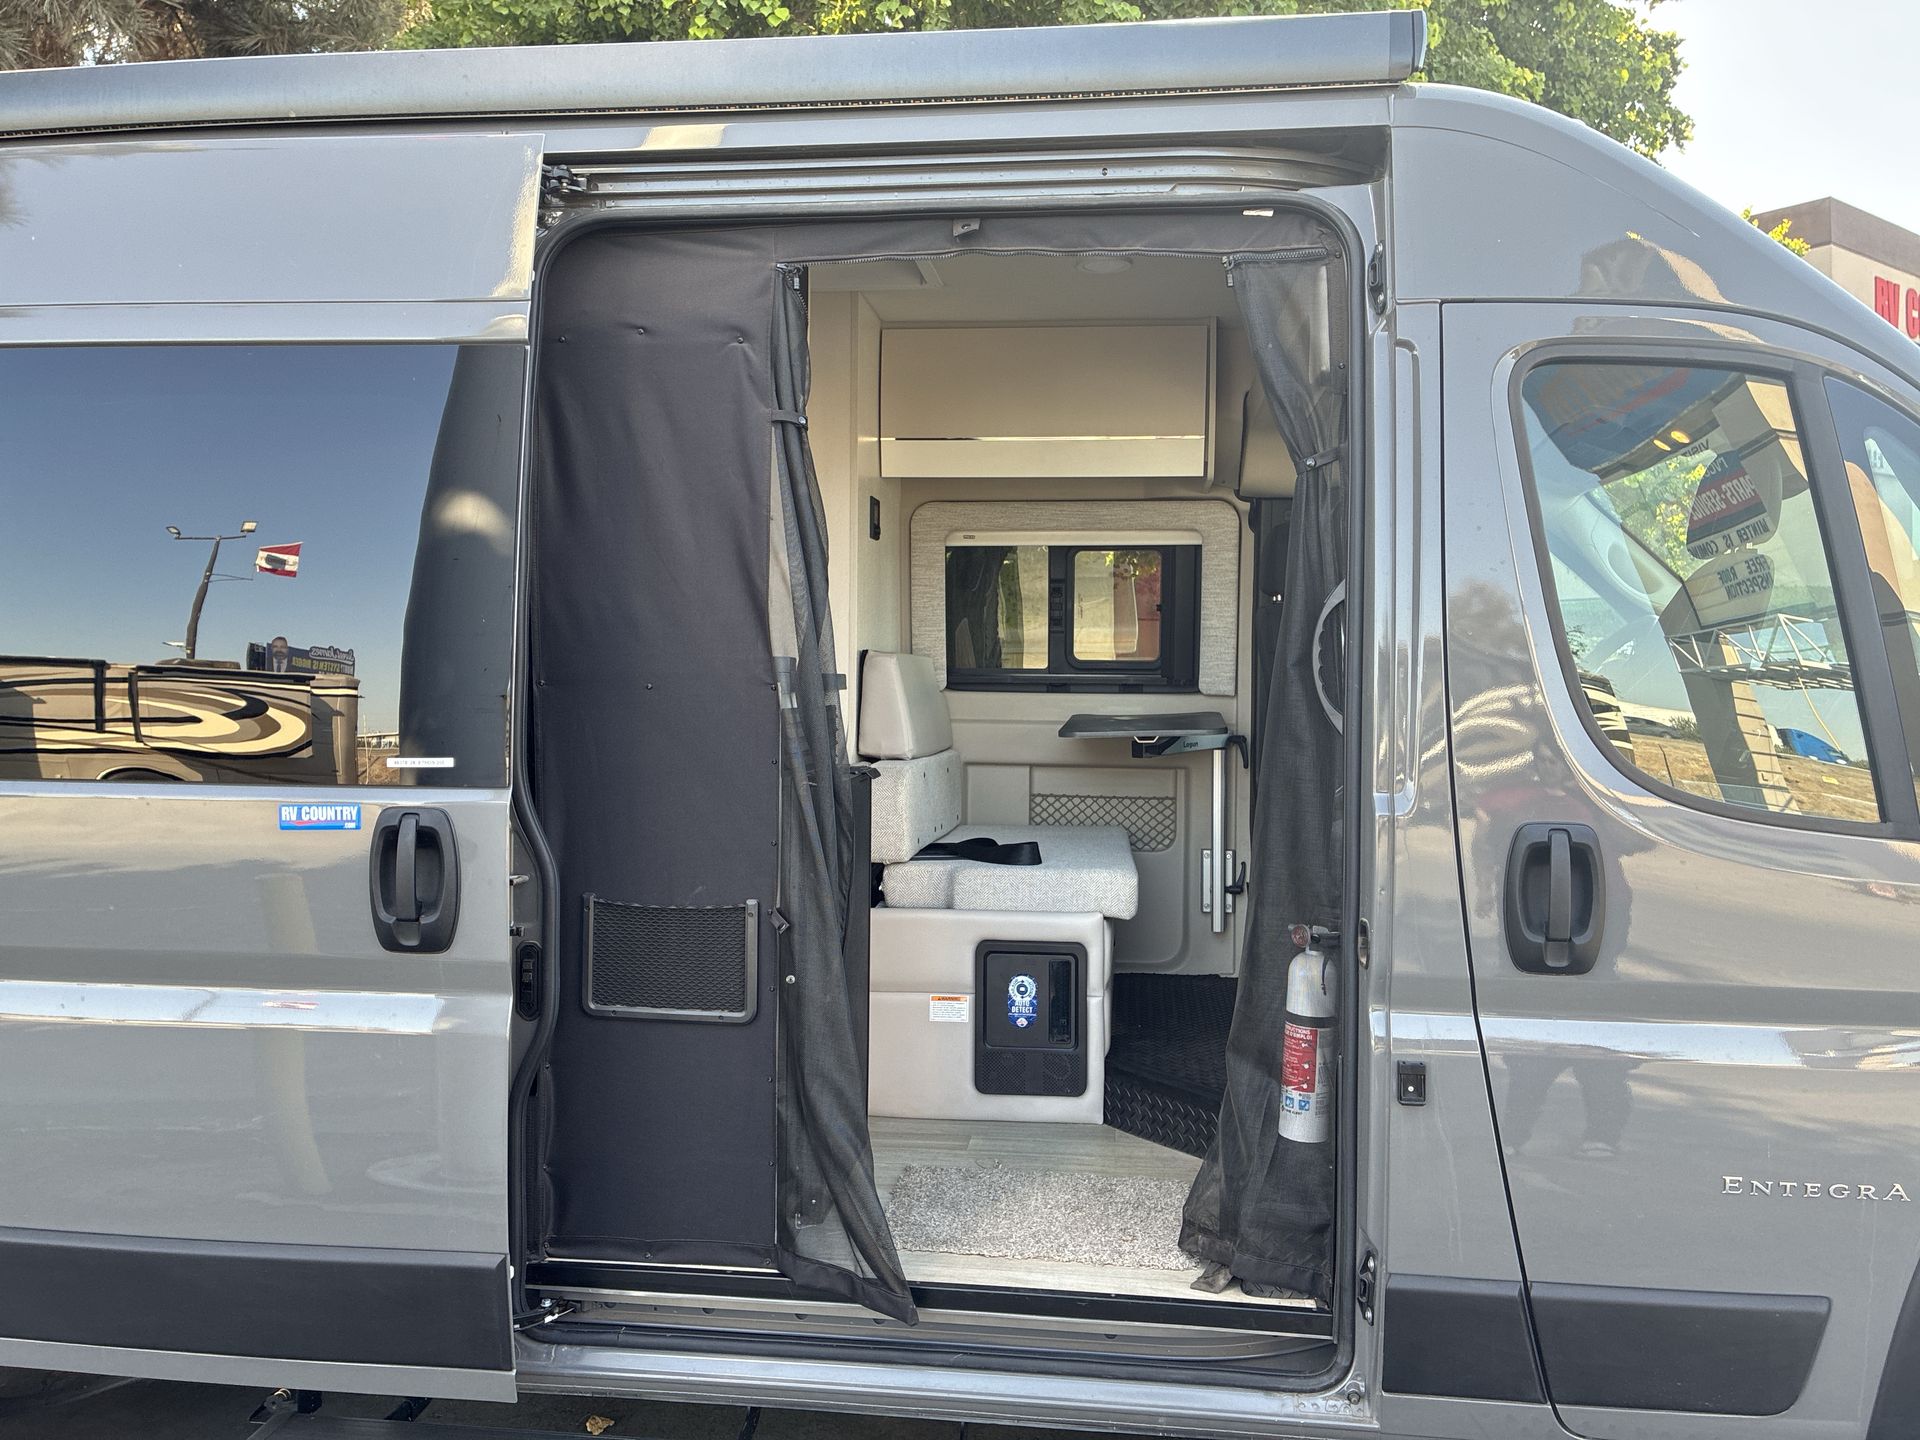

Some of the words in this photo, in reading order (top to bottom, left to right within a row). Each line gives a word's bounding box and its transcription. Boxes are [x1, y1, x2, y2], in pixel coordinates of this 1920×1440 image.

[1874, 276, 1900, 329] RV
[1905, 287, 1920, 340] C
[281, 805, 298, 821] RV
[301, 805, 358, 821] COUNTRY
[1011, 1006, 1033, 1014] DETECT
[1721, 1176, 1911, 1202] ENTEGRA
